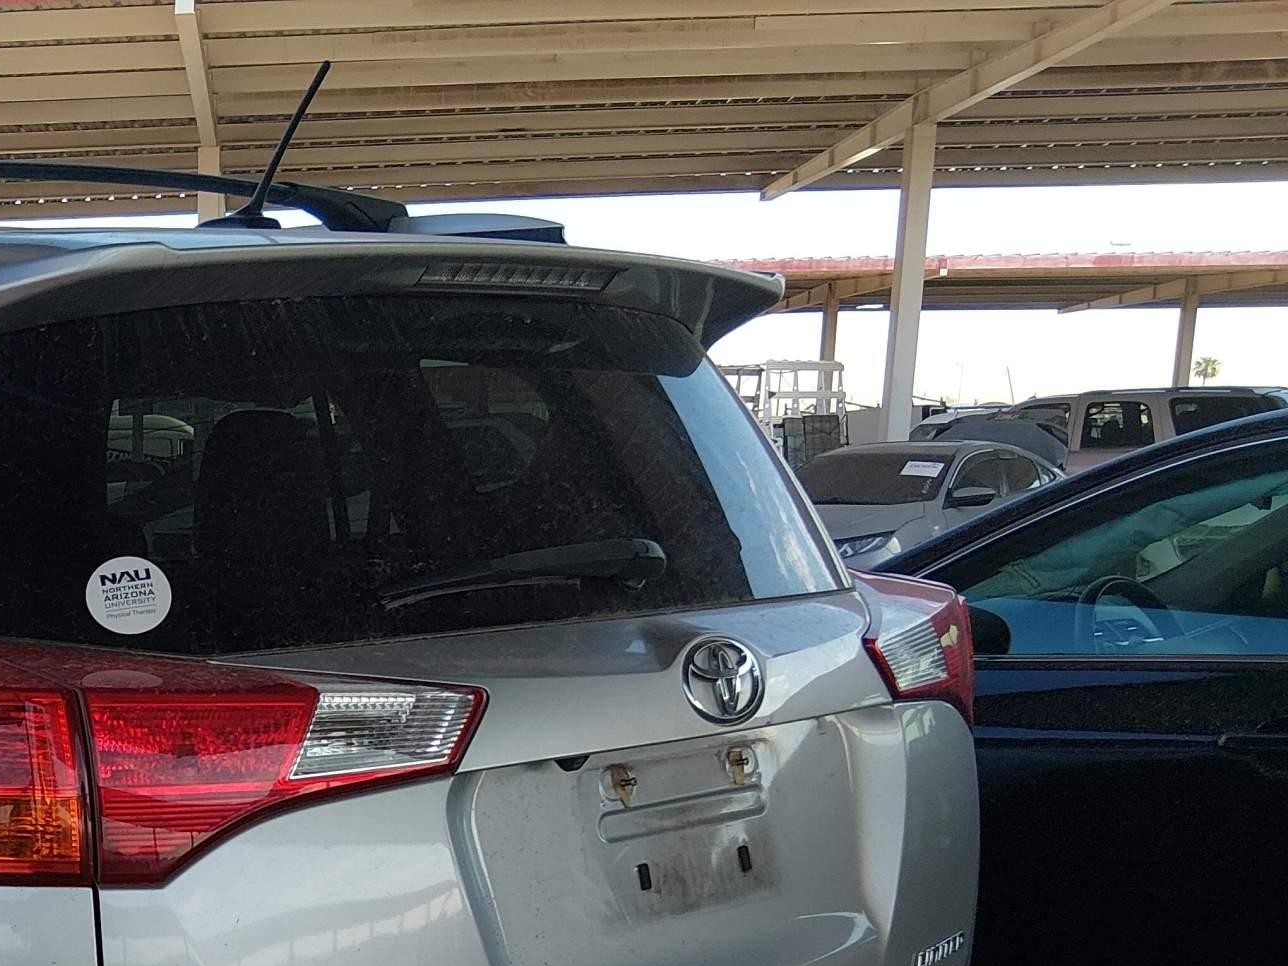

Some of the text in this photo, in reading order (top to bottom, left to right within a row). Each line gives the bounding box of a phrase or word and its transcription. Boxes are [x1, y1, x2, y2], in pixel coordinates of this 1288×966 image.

[99, 568, 152, 587] NAU
[102, 582, 153, 594] NORTHERN
[104, 589, 155, 602] ARIZONA
[105, 596, 156, 609] UNIVERSITY
